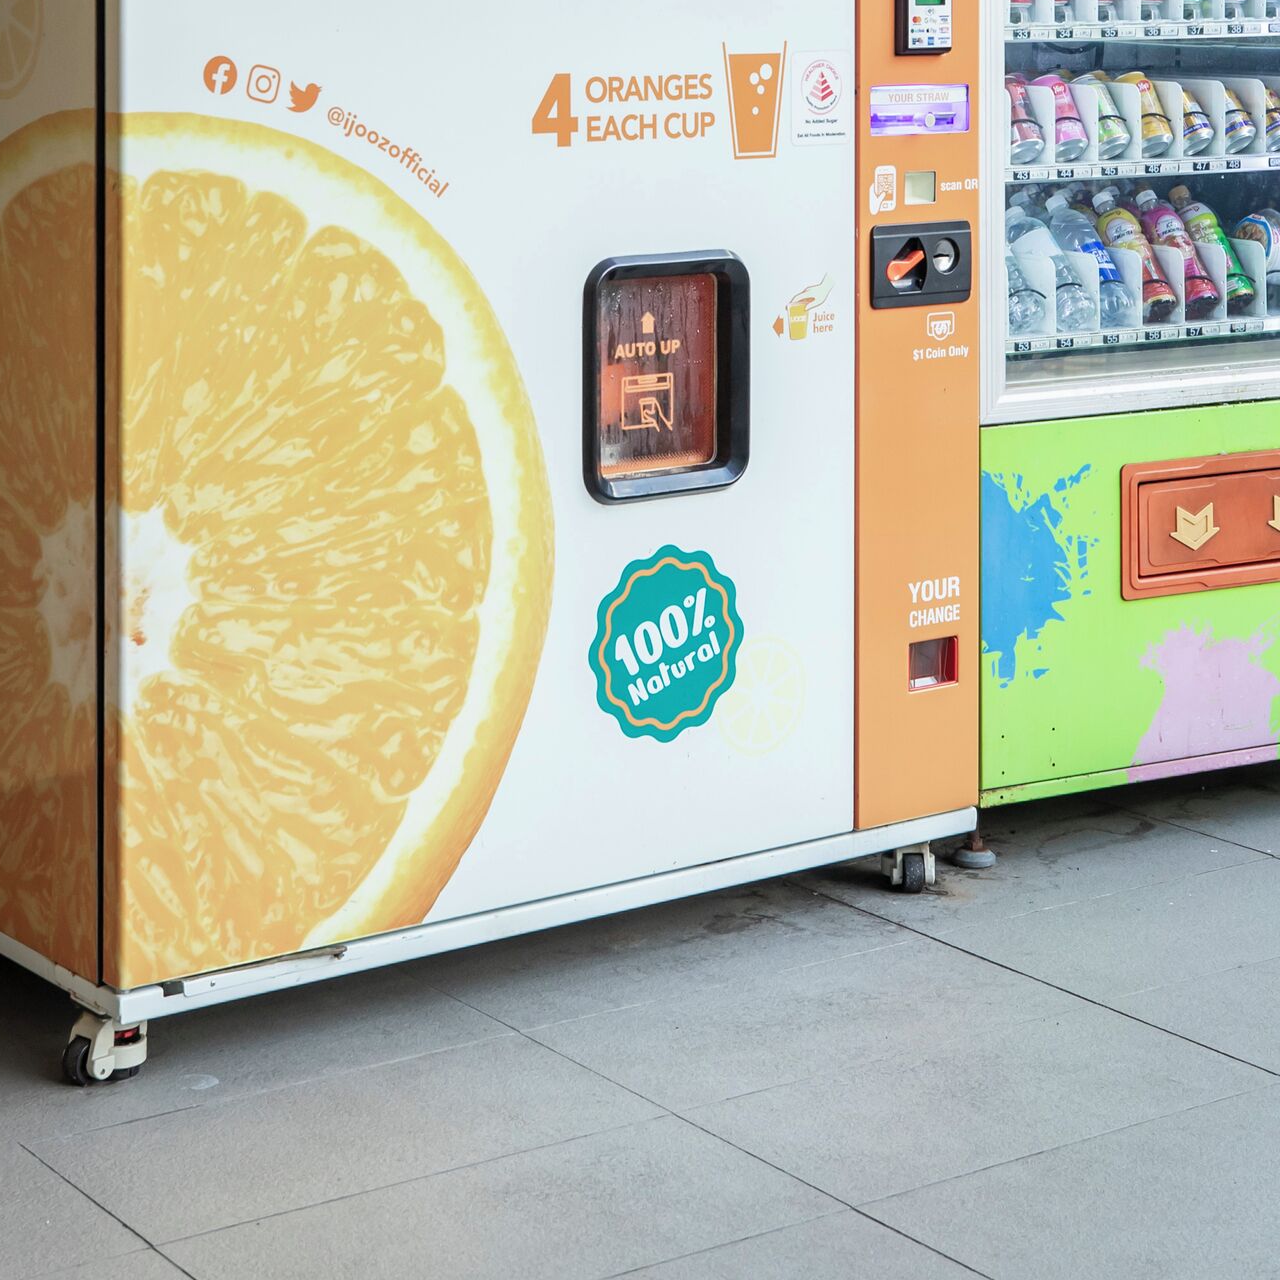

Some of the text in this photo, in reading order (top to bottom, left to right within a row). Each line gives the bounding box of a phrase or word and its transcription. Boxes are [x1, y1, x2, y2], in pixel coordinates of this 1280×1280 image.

[1231, 25, 1242, 33] 38
[585, 73, 713, 103] ORANGES
[888, 91, 950, 103] YOUR STRAW
[531, 72, 578, 147] 4
[586, 111, 716, 142] EACH CUP
[327, 106, 450, 199] @ijoozofficial
[1195, 162, 1206, 170] 47
[1228, 160, 1239, 169] 48
[940, 179, 979, 191] scan QR
[813, 311, 835, 323] Juice
[813, 322, 833, 333] here
[1190, 328, 1200, 336] 57
[1060, 339, 1071, 348] 54
[1107, 335, 1118, 344] 55
[614, 339, 680, 359] AUTO UP
[1018, 342, 1029, 351] 53
[913, 345, 969, 361] $1 Coin Only
[908, 576, 960, 604] YOUR
[909, 604, 960, 629] CHANGE
[614, 587, 717, 677] 100%
[627, 630, 721, 706] Natural
